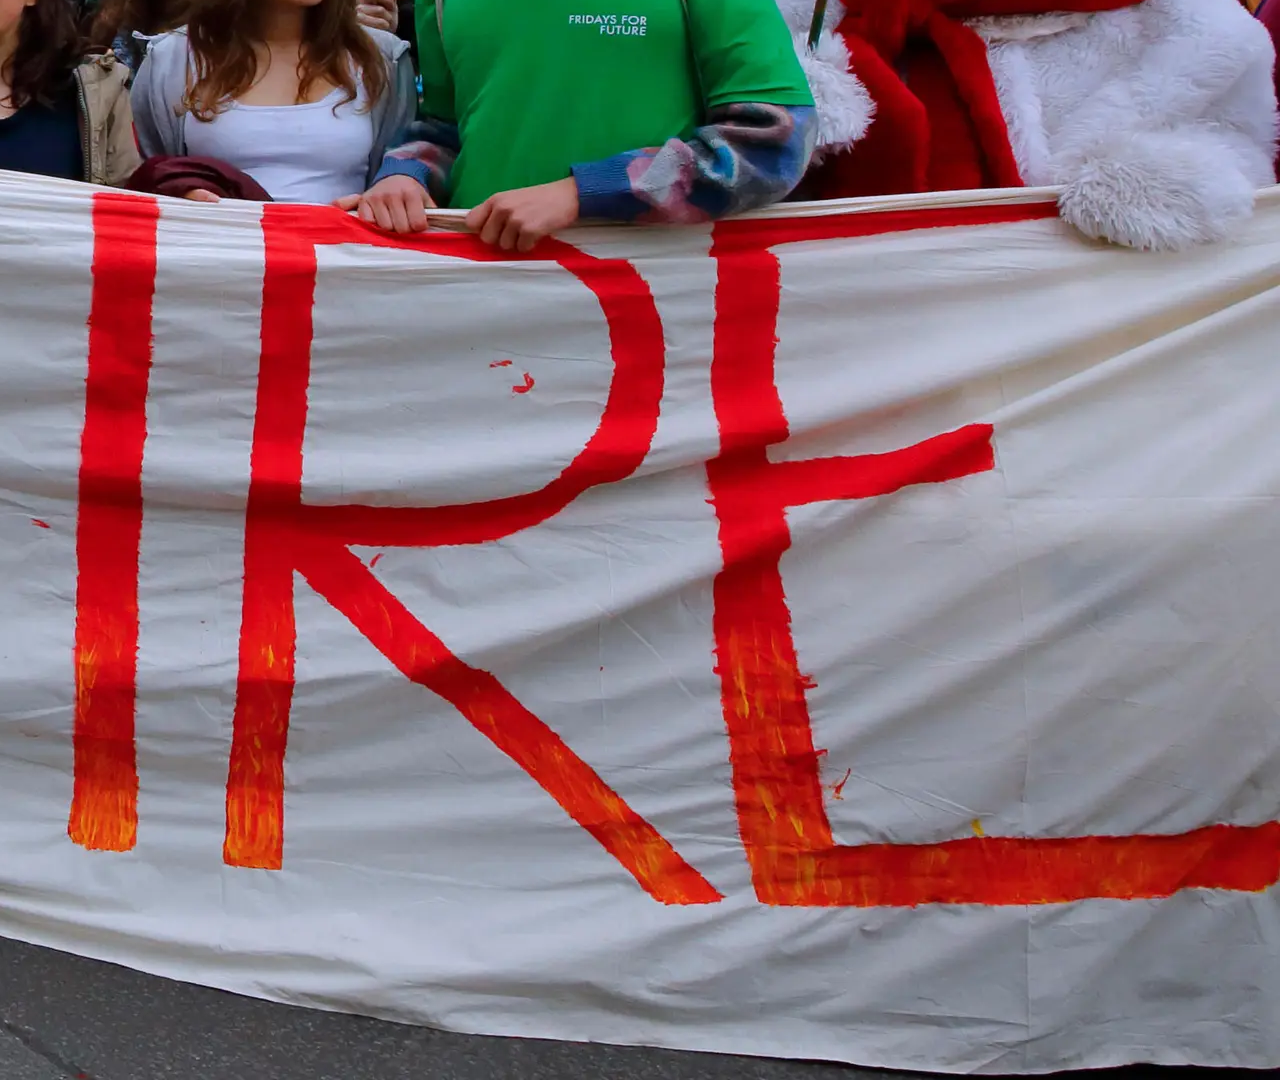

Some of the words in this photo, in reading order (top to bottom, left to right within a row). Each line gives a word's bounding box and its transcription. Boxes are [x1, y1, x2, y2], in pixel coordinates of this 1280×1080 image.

[568, 15, 618, 25] FRIDAYS
[621, 15, 647, 26] FOR
[600, 25, 647, 36] FUTURE
